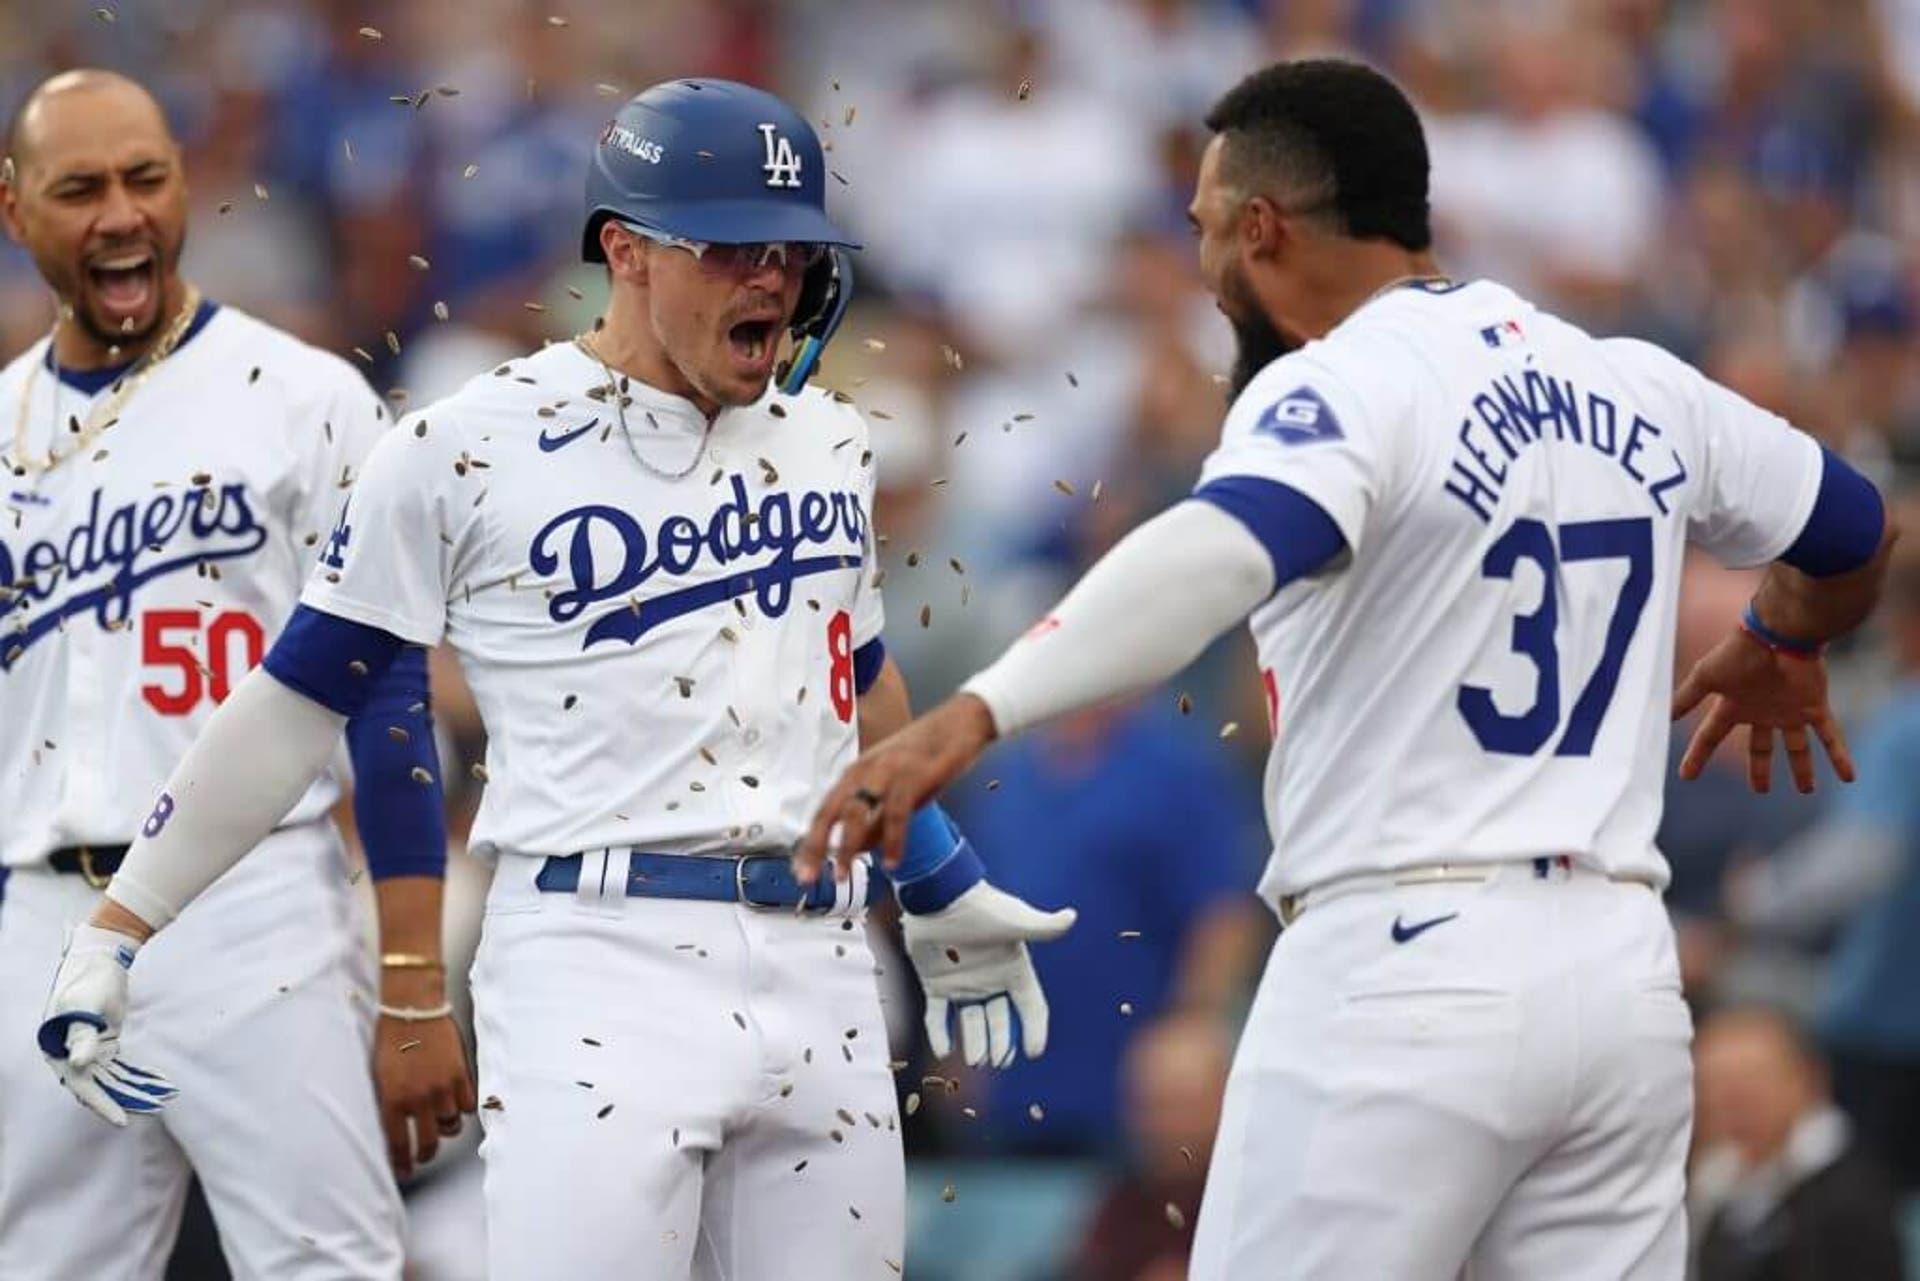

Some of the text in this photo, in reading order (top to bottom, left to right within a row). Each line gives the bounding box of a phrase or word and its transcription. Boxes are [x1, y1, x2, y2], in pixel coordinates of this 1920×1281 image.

[757, 122, 802, 187] LA
[1445, 354, 1687, 523] HERNÁNDEZ
[0, 483, 257, 632] odgers
[529, 473, 868, 620] Dodgers
[141, 609, 265, 717] 50
[827, 609, 855, 724] 8
[1457, 516, 1654, 757] 37
[142, 792, 174, 839] 8
